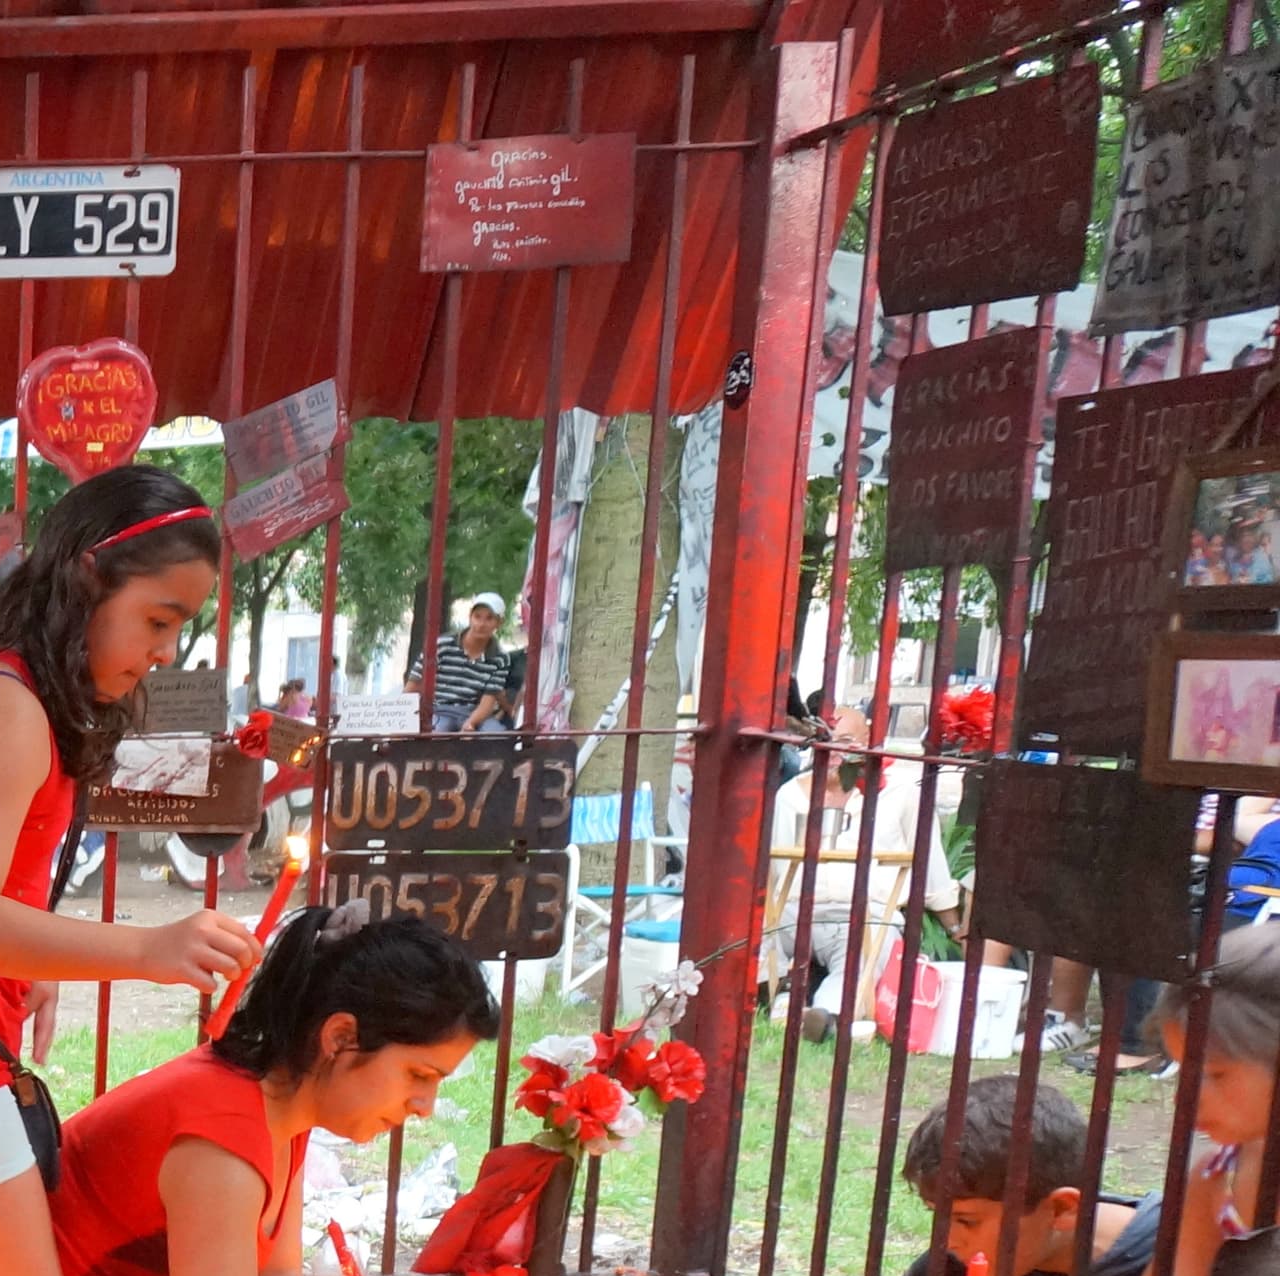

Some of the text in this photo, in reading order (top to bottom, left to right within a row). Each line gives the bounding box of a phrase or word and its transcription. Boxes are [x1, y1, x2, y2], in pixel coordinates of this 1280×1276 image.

[10, 171, 104, 187] ARGENTINA
[73, 192, 169, 254] 529
[100, 397, 122, 414] EL
